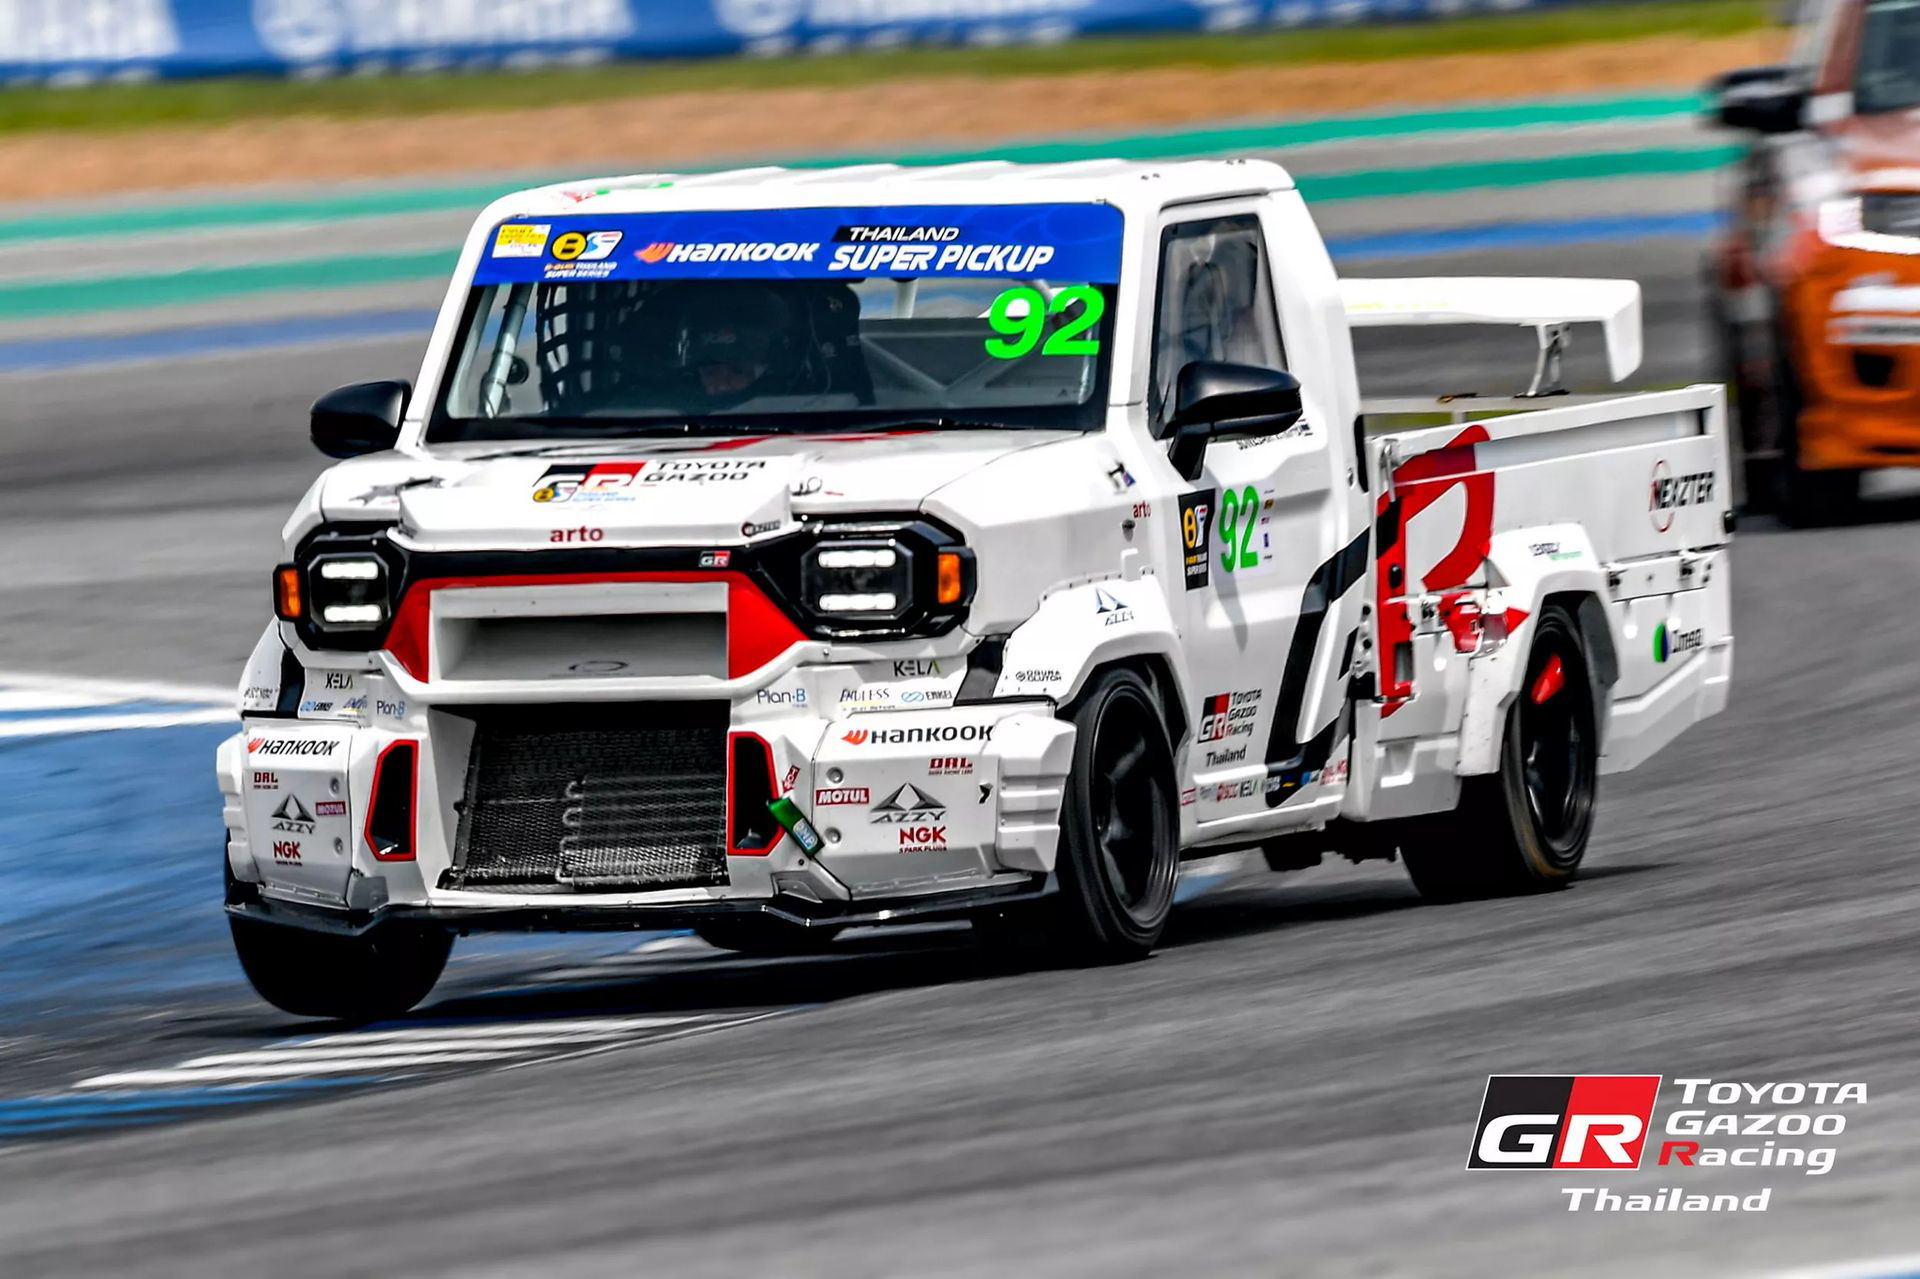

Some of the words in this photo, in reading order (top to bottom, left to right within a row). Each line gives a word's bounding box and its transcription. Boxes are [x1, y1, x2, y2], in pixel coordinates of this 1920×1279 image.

[849, 226, 960, 241] THAILAND
[828, 244, 938, 272] SUPER
[935, 244, 1055, 273] PICKUP
[984, 283, 1106, 360] 92
[658, 461, 766, 471] TOYOTA
[644, 472, 749, 483] GAZOO
[1132, 500, 1152, 519] arto
[550, 524, 604, 543] arto
[1218, 485, 1260, 574] 92
[700, 555, 731, 567] GR
[893, 658, 942, 677] KELA
[1231, 689, 1262, 705] TOYOTA
[1228, 706, 1257, 721] GAZOO
[1199, 713, 1227, 741] GR
[1226, 722, 1254, 737] Racing
[1206, 744, 1247, 767] Thailand
[818, 789, 869, 805] MOTUL
[870, 811, 947, 824] AZZY
[271, 820, 316, 834] AZZY
[899, 825, 947, 845] NGK
[272, 840, 301, 859] NGK
